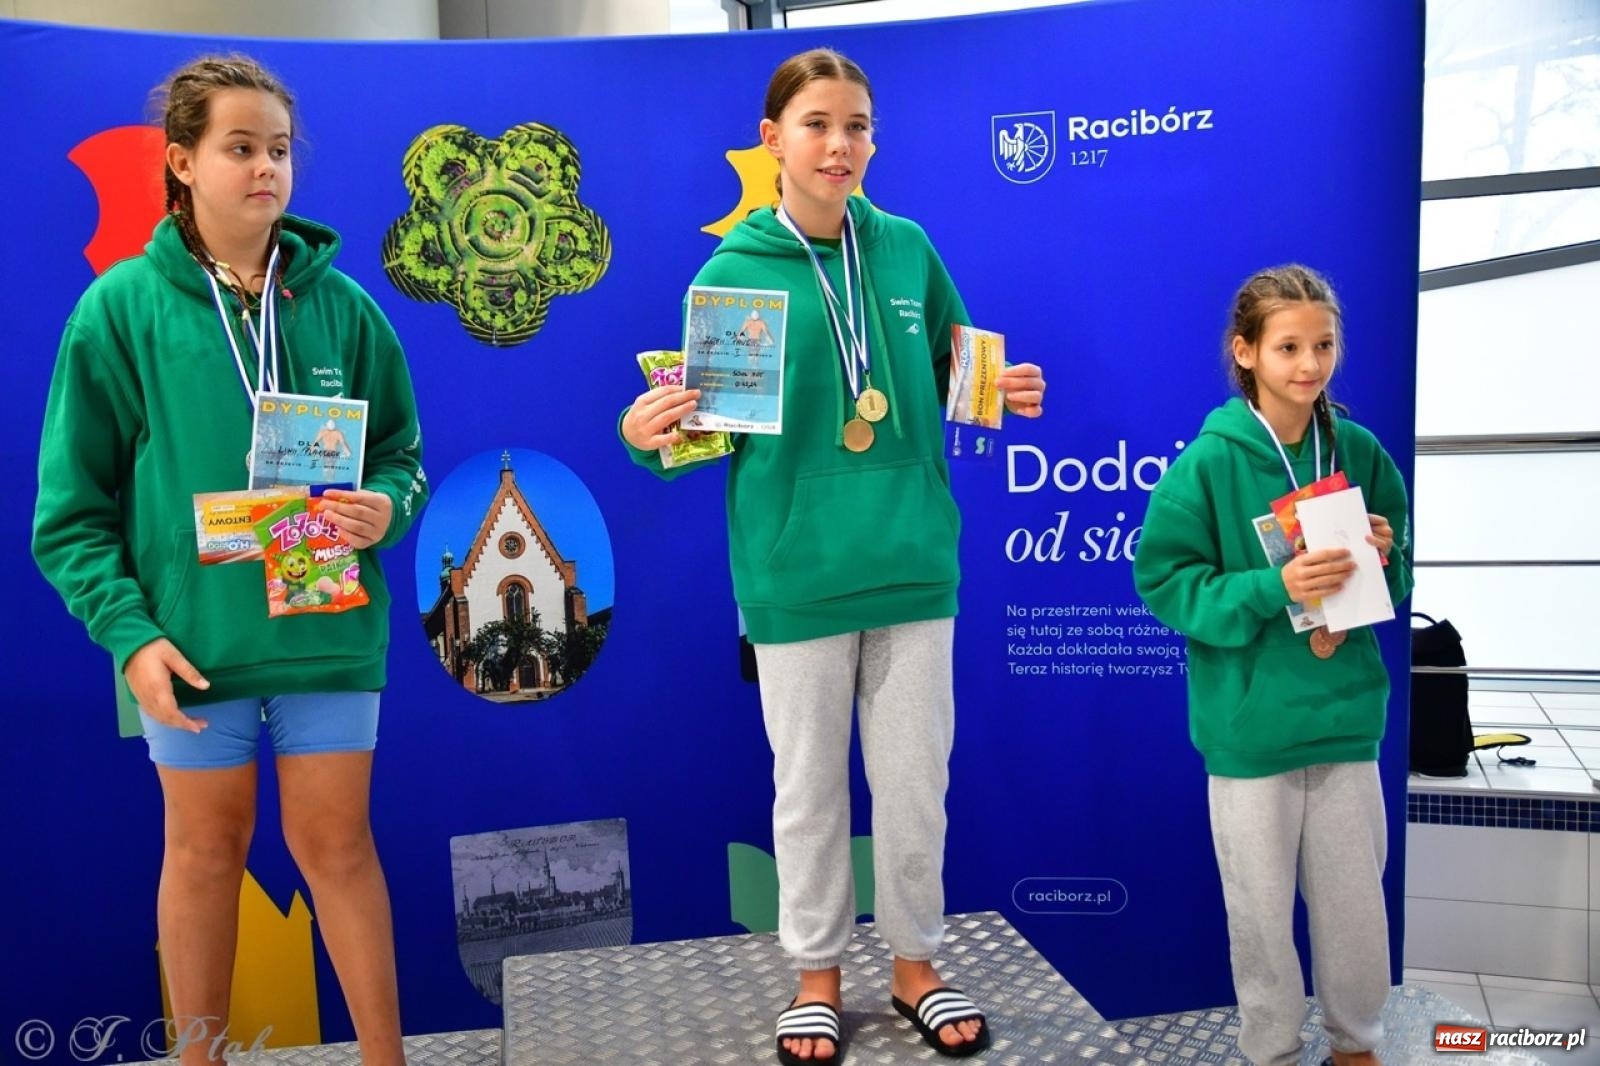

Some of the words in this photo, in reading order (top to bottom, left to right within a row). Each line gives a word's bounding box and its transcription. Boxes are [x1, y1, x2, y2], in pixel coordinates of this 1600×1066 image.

[1068, 106, 1214, 141] Racibórz
[1070, 150, 1108, 168] 1217
[694, 295, 783, 309] DYPLOM
[312, 367, 333, 375] Swim
[979, 340, 987, 396] PREZENTOWY
[262, 401, 361, 420] DYPLOM
[1006, 439, 1186, 494] Doda
[208, 515, 251, 527] ENTOWY
[1005, 510, 1071, 564] od
[1079, 511, 1145, 563] sie
[1006, 605, 1027, 617] Na
[1031, 604, 1112, 619] przestrzeni
[1007, 625, 1026, 639] się
[1030, 624, 1063, 639] tutaj
[1066, 627, 1083, 636] ze
[1087, 624, 1124, 639] sobą
[1128, 624, 1169, 636] różne
[1007, 643, 1052, 656] Każda
[1056, 643, 1132, 656] dokładała
[1136, 645, 1180, 659] swoją
[1007, 662, 1048, 675] Teraz
[1051, 662, 1104, 677] historię
[1108, 662, 1173, 678] tworzysz
[1029, 889, 1111, 905] raciborz.pl
